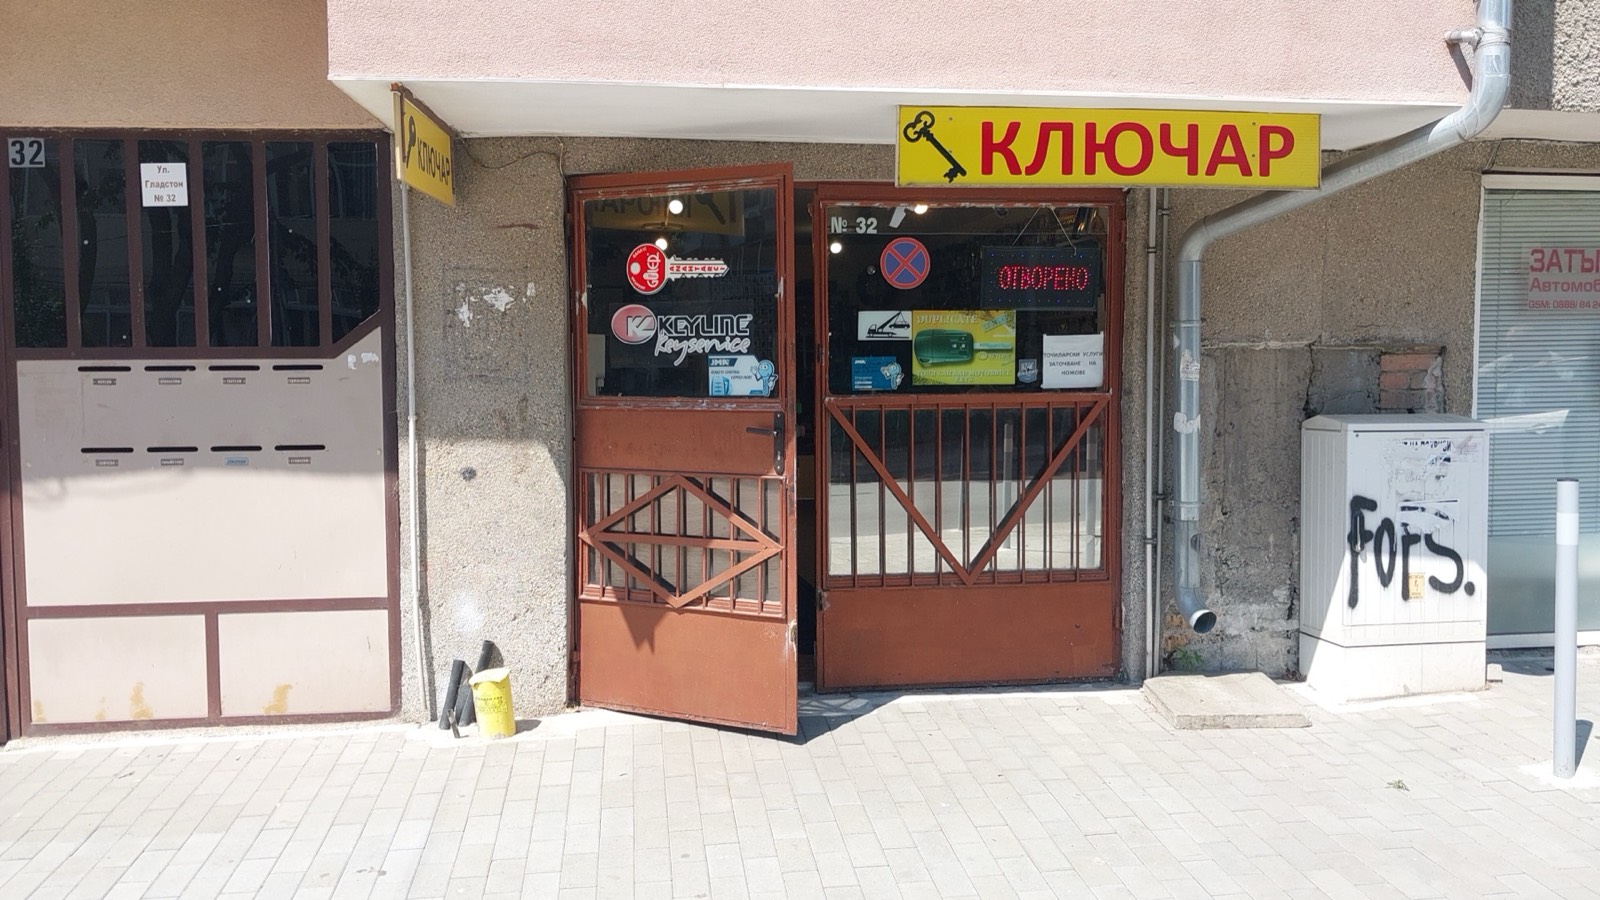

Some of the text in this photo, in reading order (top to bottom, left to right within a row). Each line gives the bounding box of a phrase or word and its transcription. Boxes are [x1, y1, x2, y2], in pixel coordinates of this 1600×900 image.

[11, 140, 44, 166] 32
[981, 121, 1295, 177] КЛЮЧАР
[157, 166, 170, 174] Ул.
[417, 137, 450, 186] КЛЮЧАР
[145, 180, 184, 190] Гладстон
[154, 194, 176, 202] № 32
[830, 216, 878, 234] № 32
[999, 265, 1088, 291] ОТВОРЕНО
[1528, 300, 1551, 309] GSM:
[1580, 300, 1591, 309] 84
[658, 314, 750, 337] KEYLINE
